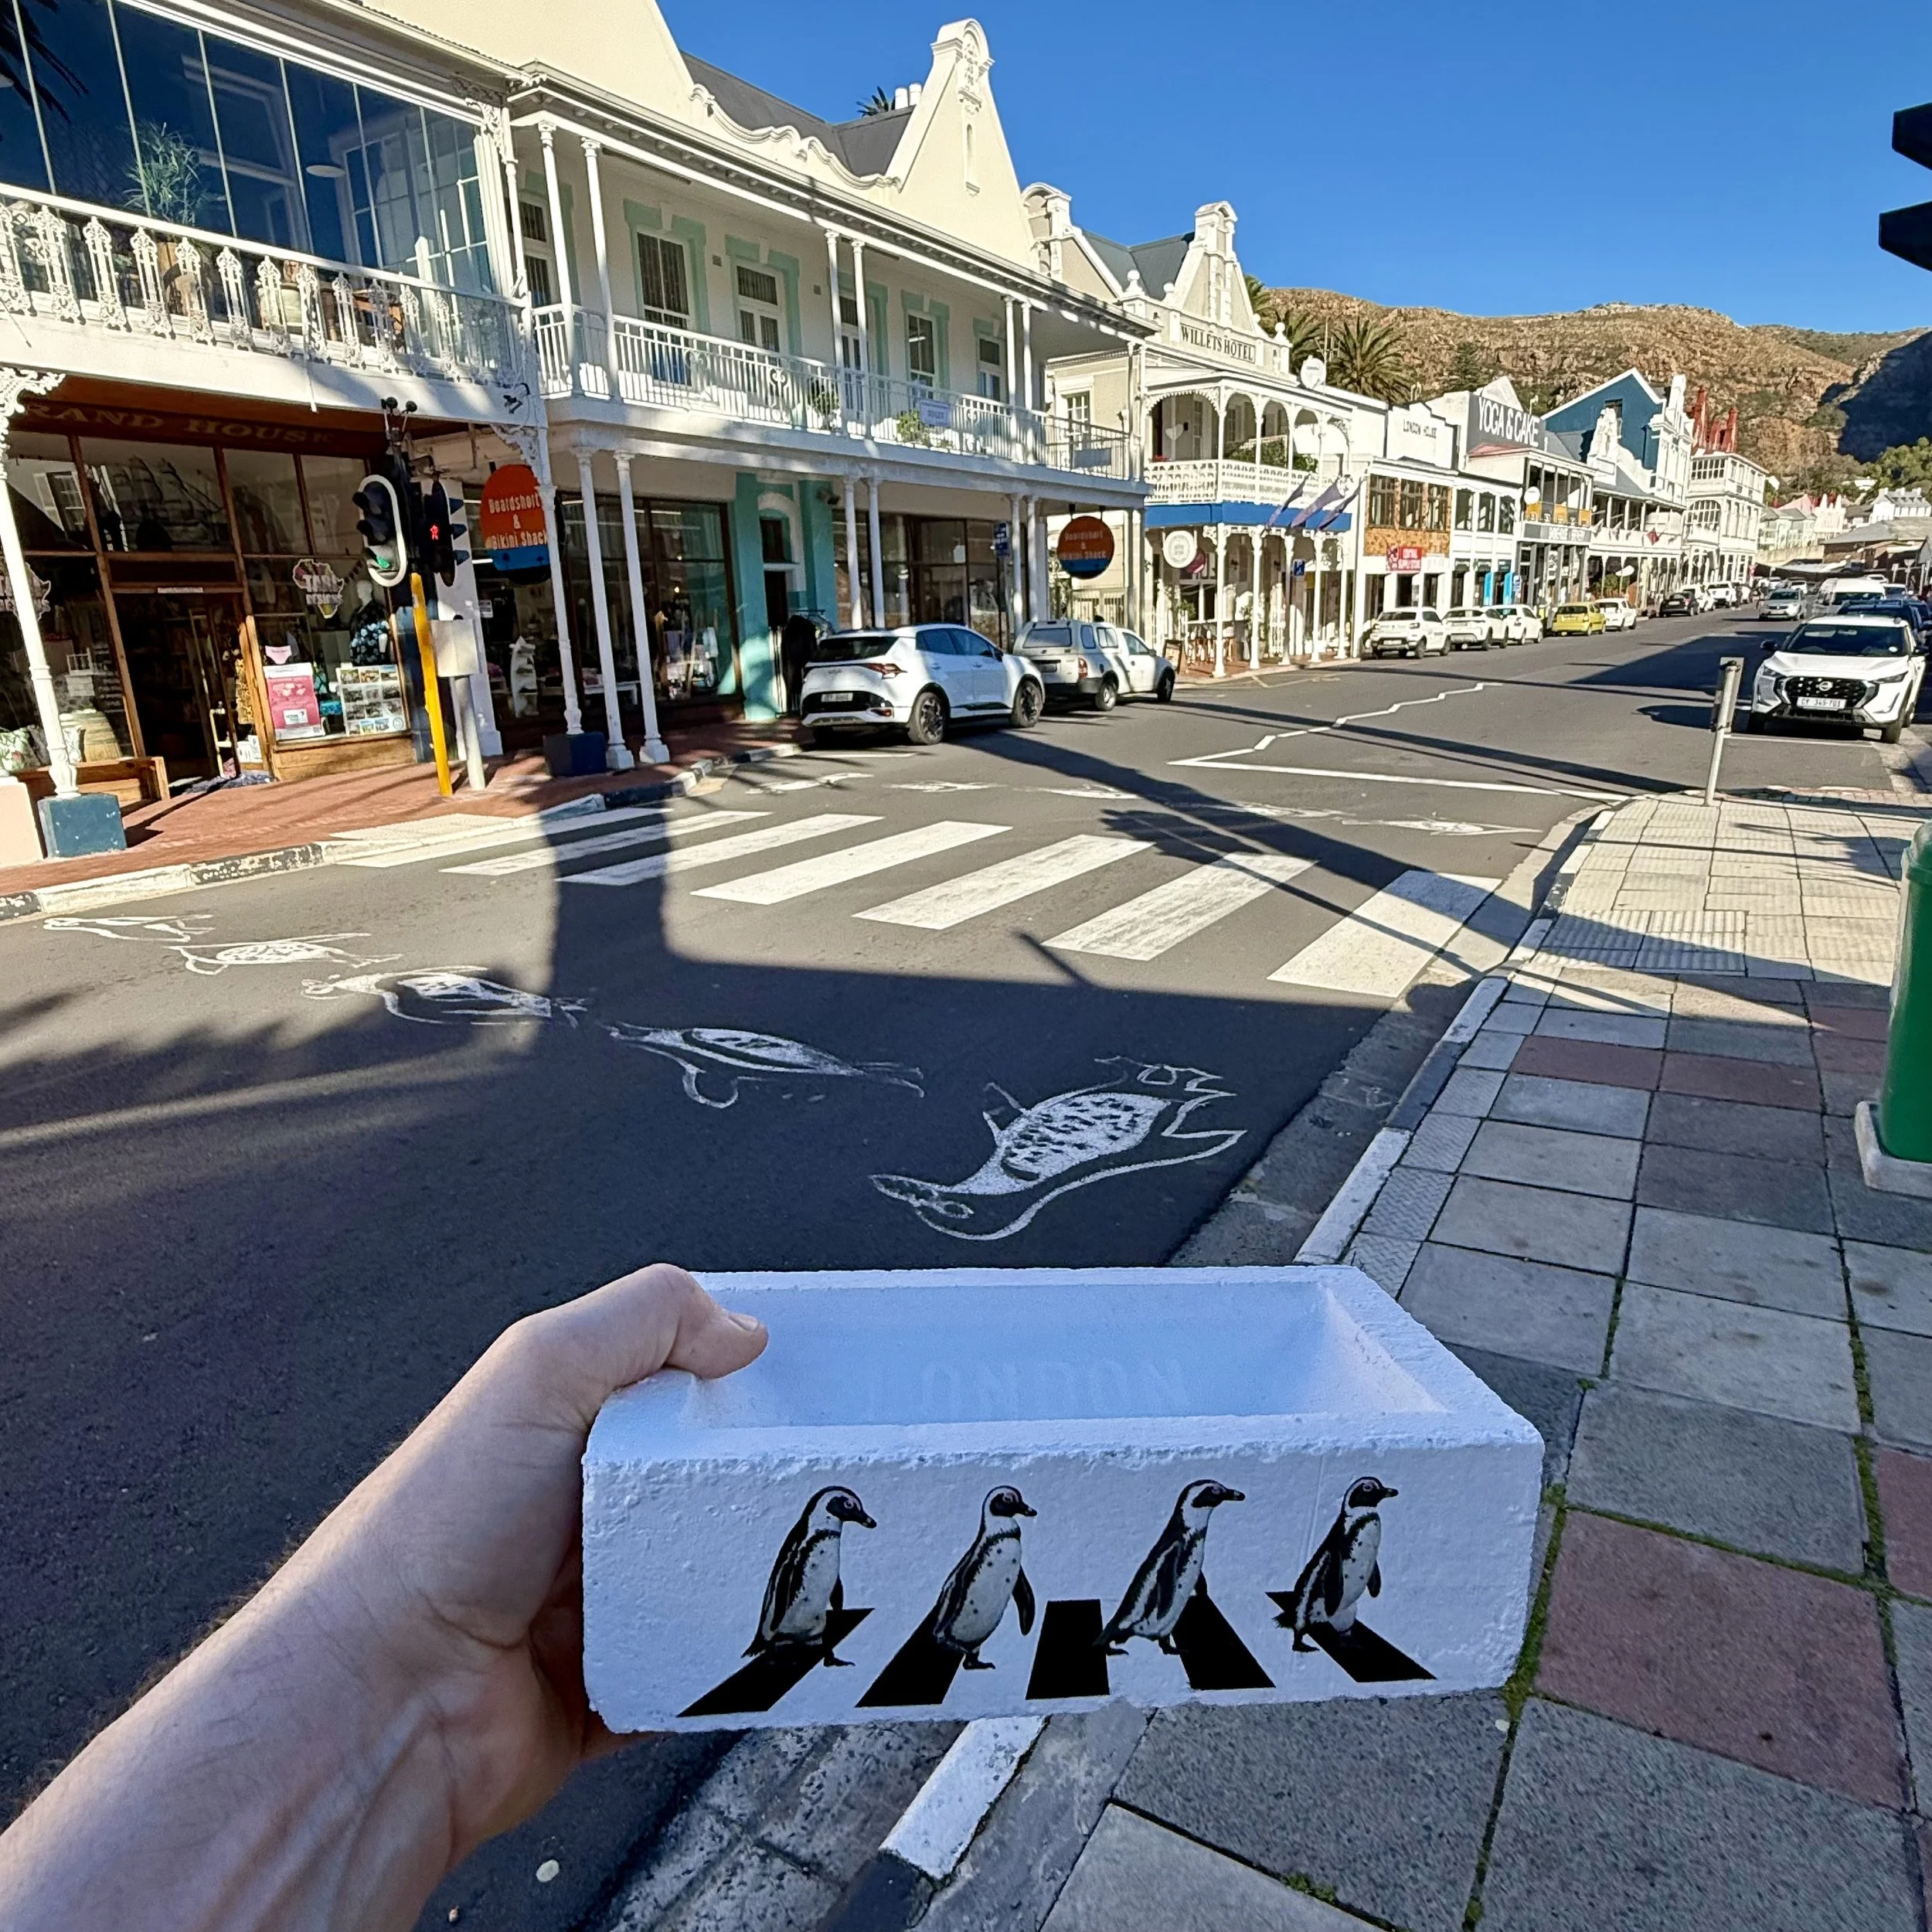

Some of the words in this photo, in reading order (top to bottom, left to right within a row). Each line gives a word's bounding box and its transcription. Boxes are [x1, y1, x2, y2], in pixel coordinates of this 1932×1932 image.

[1181, 325, 1223, 352] WILLETS
[1224, 339, 1253, 361] HOTEL
[25, 403, 165, 428] RAND
[1478, 396, 1505, 437] YOGA
[1505, 408, 1514, 440] &
[1514, 411, 1541, 447] CAKE
[488, 492, 541, 514] Boardshort
[512, 513, 521, 529] &
